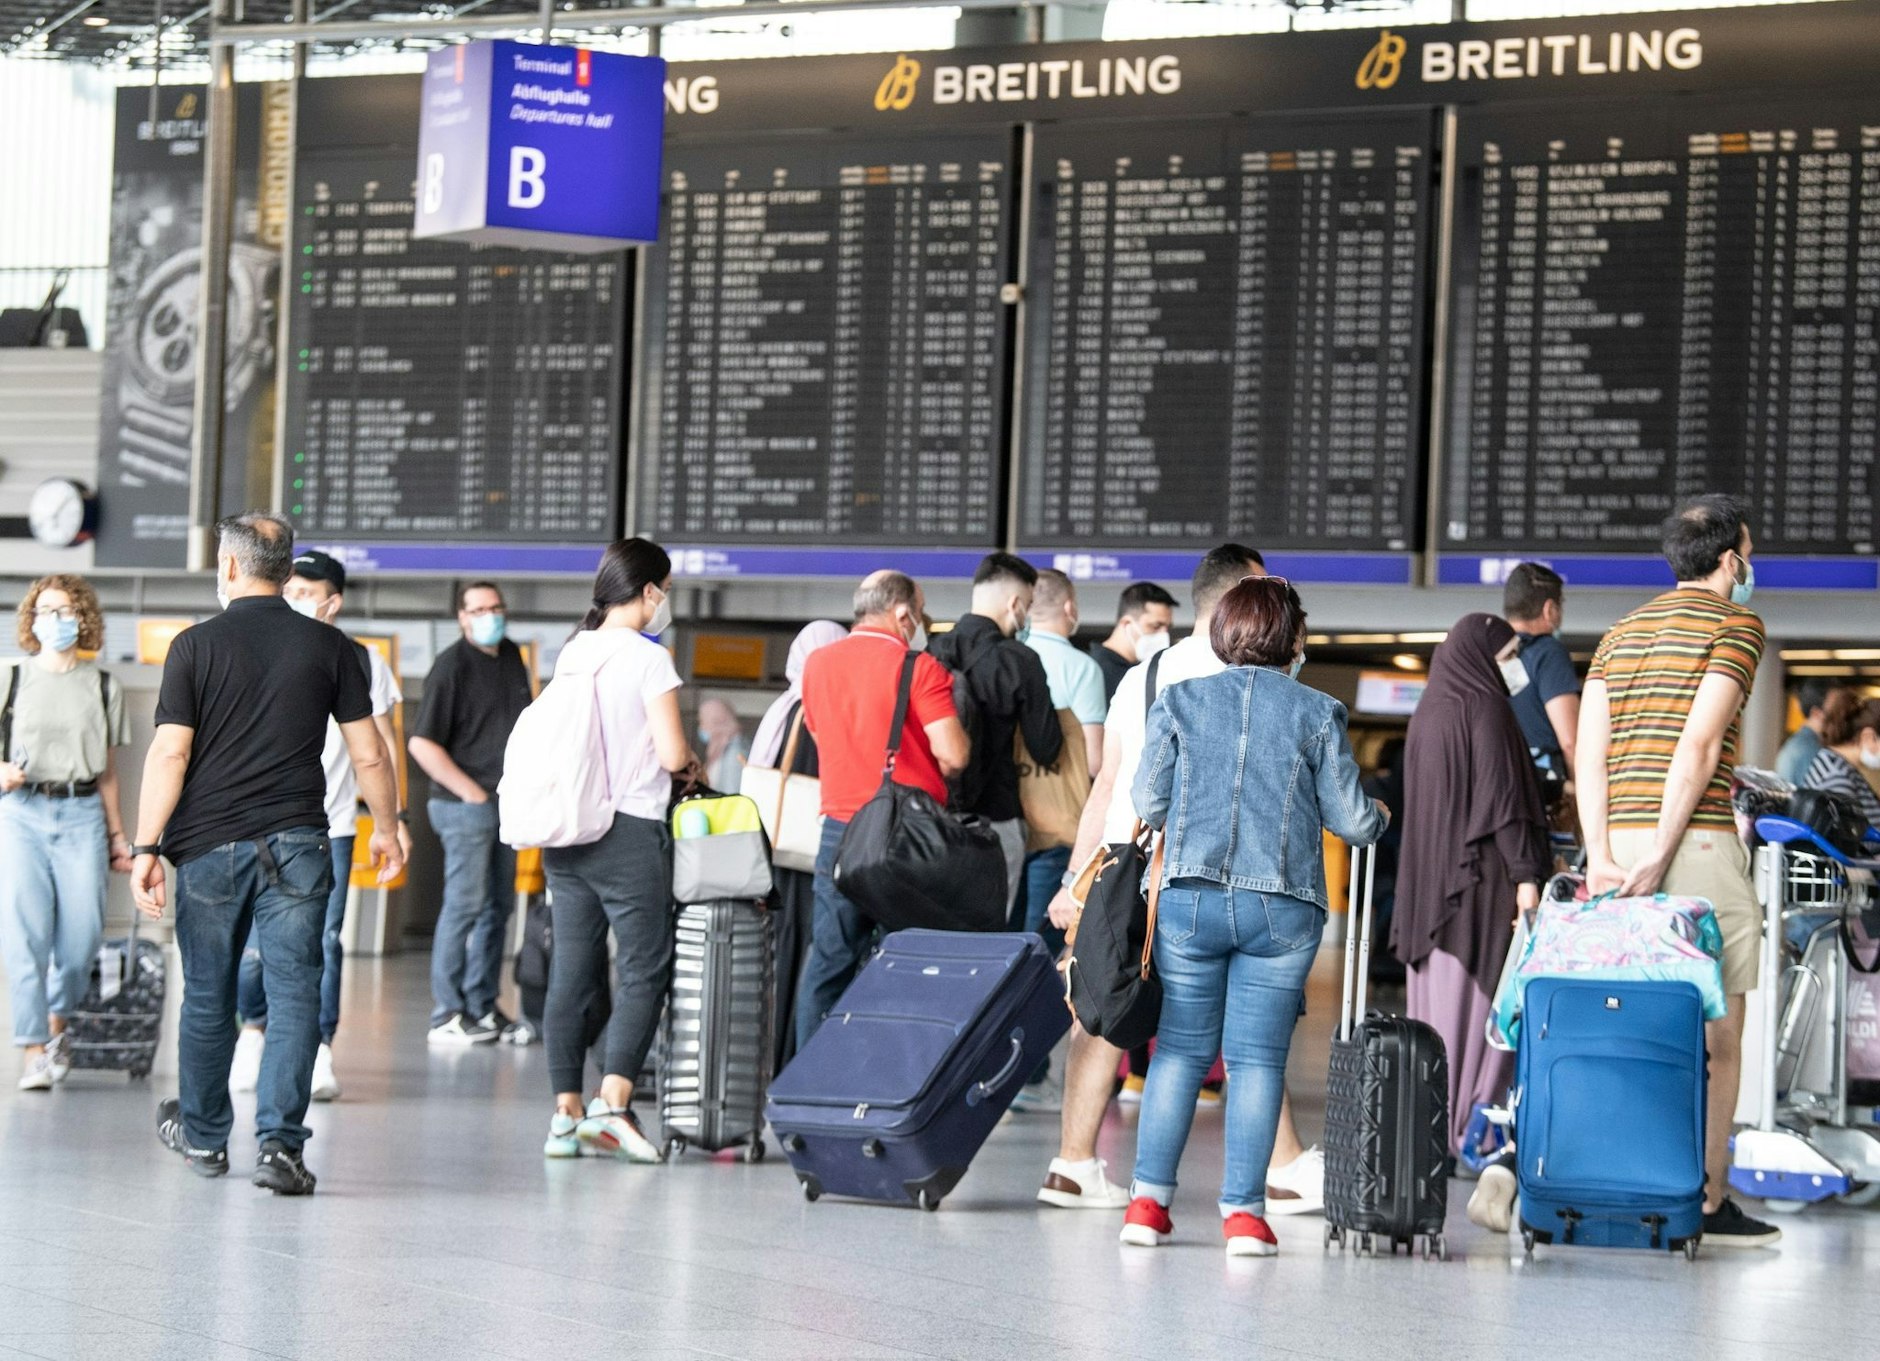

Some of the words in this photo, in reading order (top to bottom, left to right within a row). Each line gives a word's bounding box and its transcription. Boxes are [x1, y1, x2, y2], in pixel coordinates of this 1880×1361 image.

[514, 54, 573, 76] Terminal
[578, 62, 589, 77] 1
[933, 55, 1182, 104] BREITLING
[1421, 28, 1703, 82] BREITLING
[509, 104, 584, 127] Departures
[585, 112, 614, 129] hall
[511, 83, 592, 107] Abflughalle
[423, 152, 445, 215] B
[507, 145, 547, 209] B
